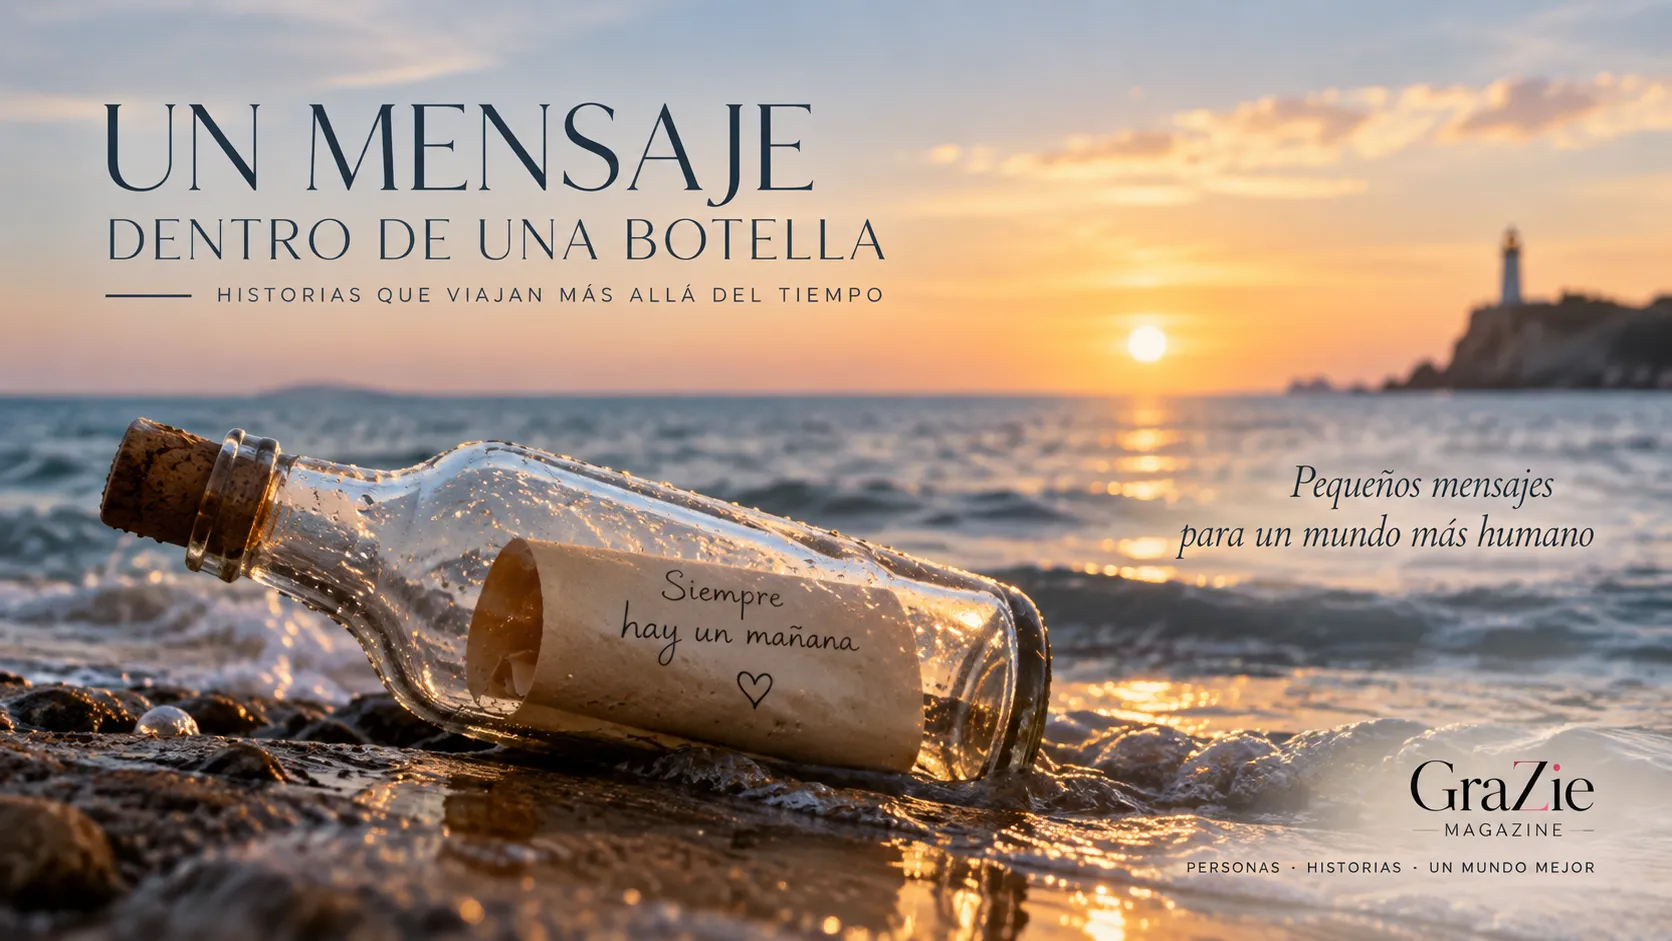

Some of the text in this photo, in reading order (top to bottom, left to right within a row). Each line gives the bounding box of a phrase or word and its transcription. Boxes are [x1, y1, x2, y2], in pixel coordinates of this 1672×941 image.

[661, 569, 784, 621] Siempre
[620, 599, 860, 667] hay un mañana
